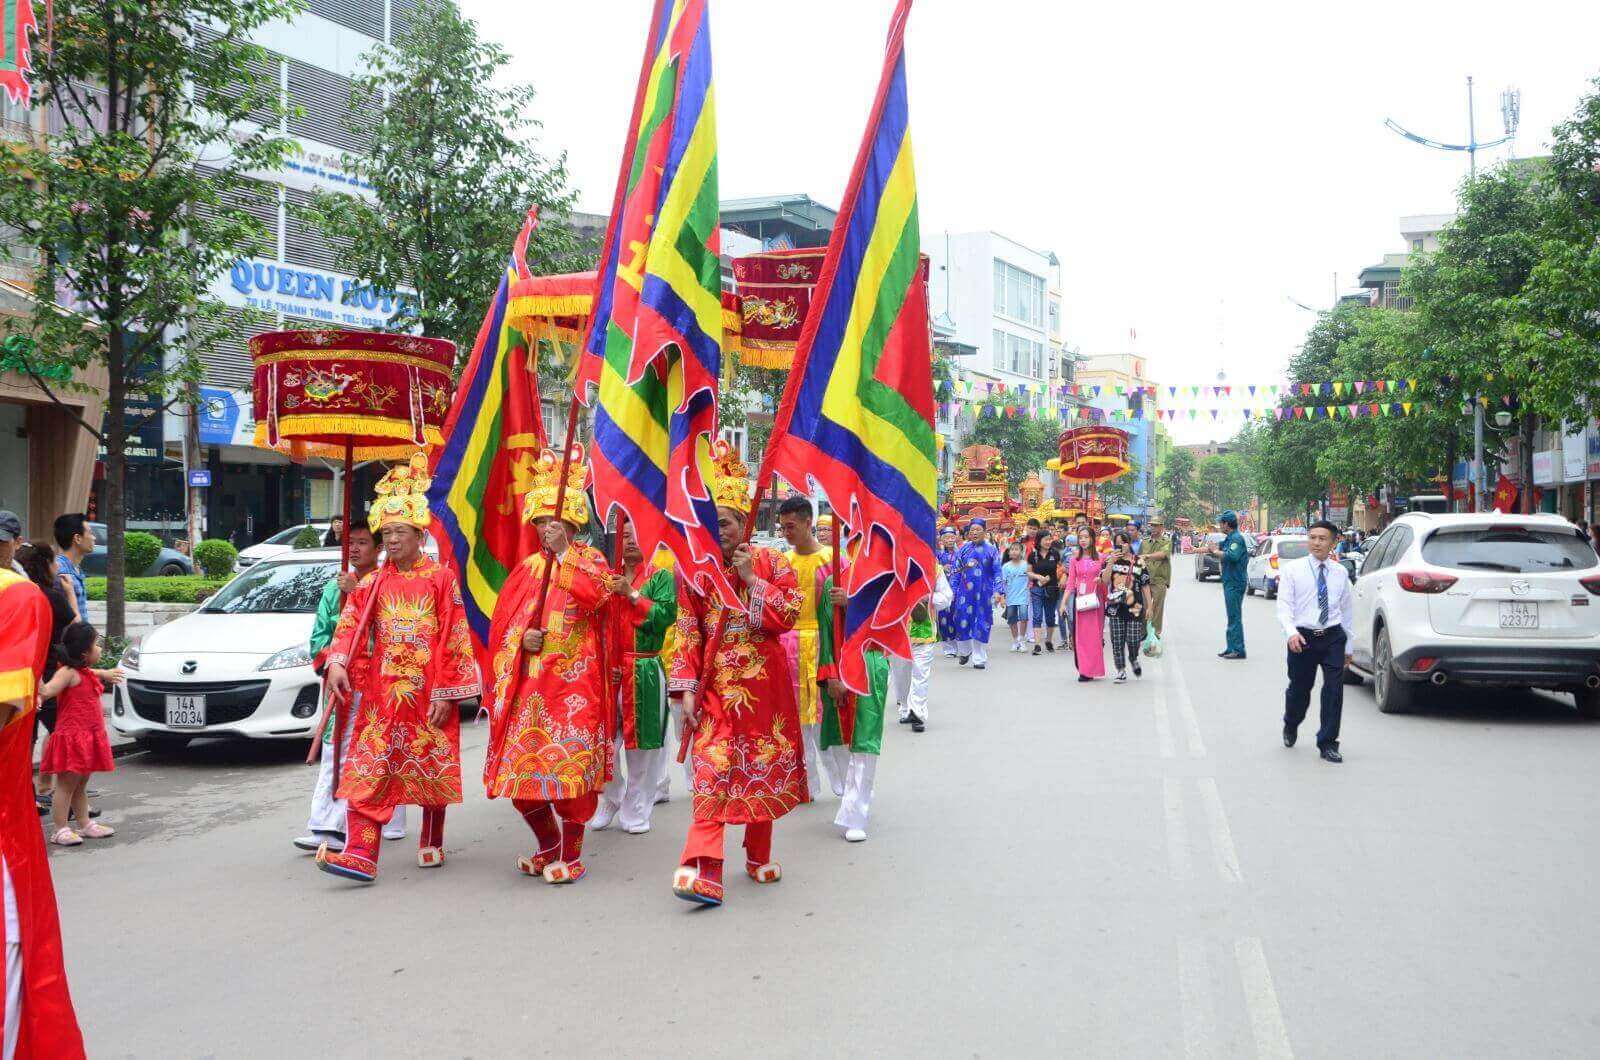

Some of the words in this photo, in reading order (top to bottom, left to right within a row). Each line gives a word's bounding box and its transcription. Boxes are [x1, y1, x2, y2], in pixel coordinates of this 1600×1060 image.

[231, 258, 335, 302] QUEEN
[1511, 602, 1529, 615] 14A
[176, 697, 195, 710] 14A
[169, 710, 203, 724] 120.34
